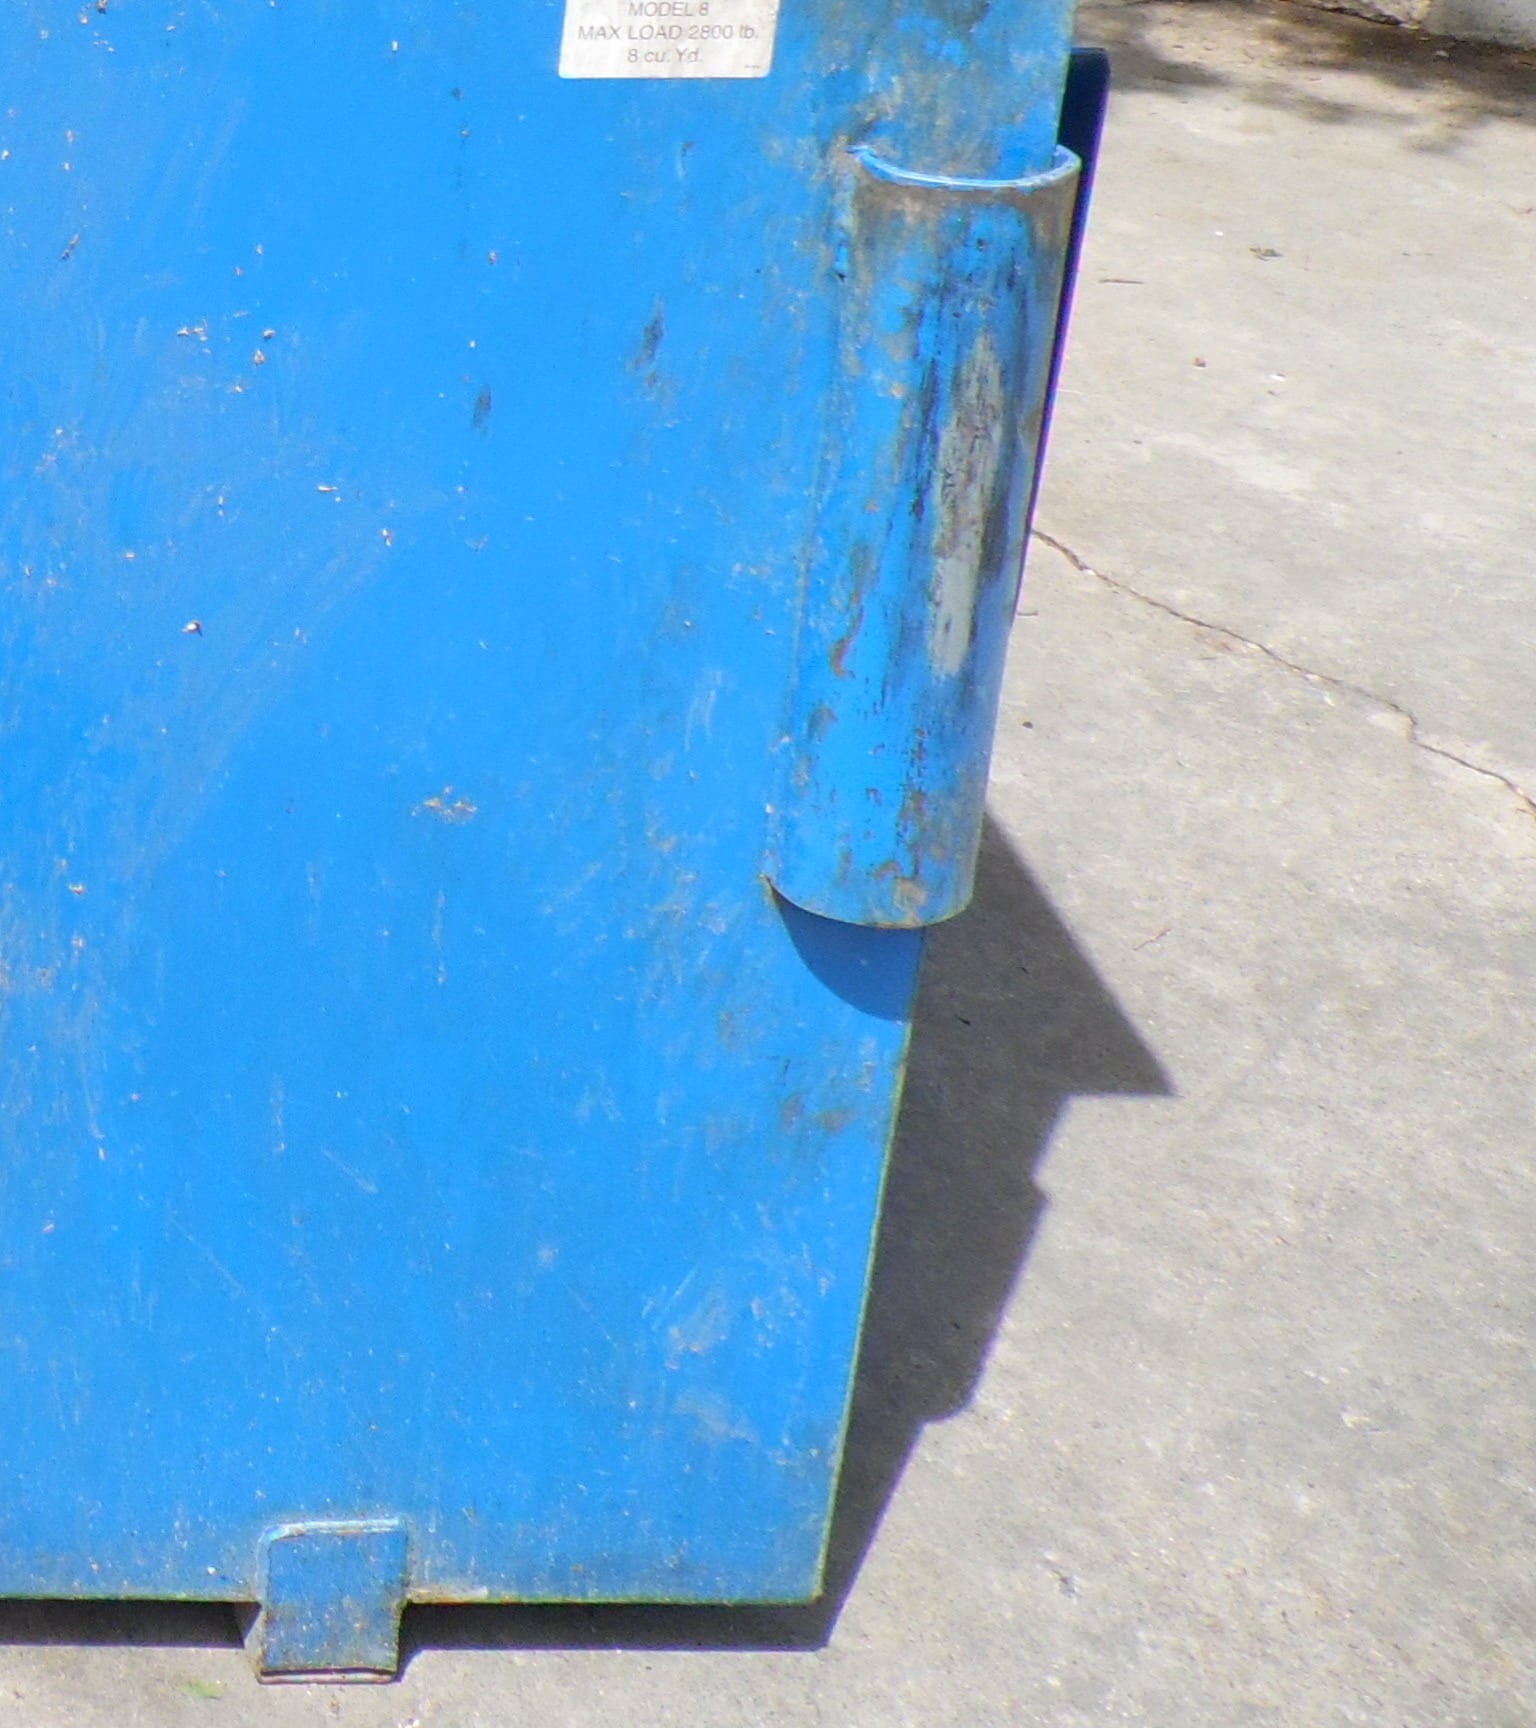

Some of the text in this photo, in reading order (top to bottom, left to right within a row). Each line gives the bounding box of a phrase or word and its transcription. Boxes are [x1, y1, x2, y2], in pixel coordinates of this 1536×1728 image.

[627, 1, 710, 18] MODEL 8
[577, 25, 622, 41] MAX
[626, 24, 683, 41] LOAD
[687, 24, 734, 40] 2800
[626, 48, 639, 64] 8
